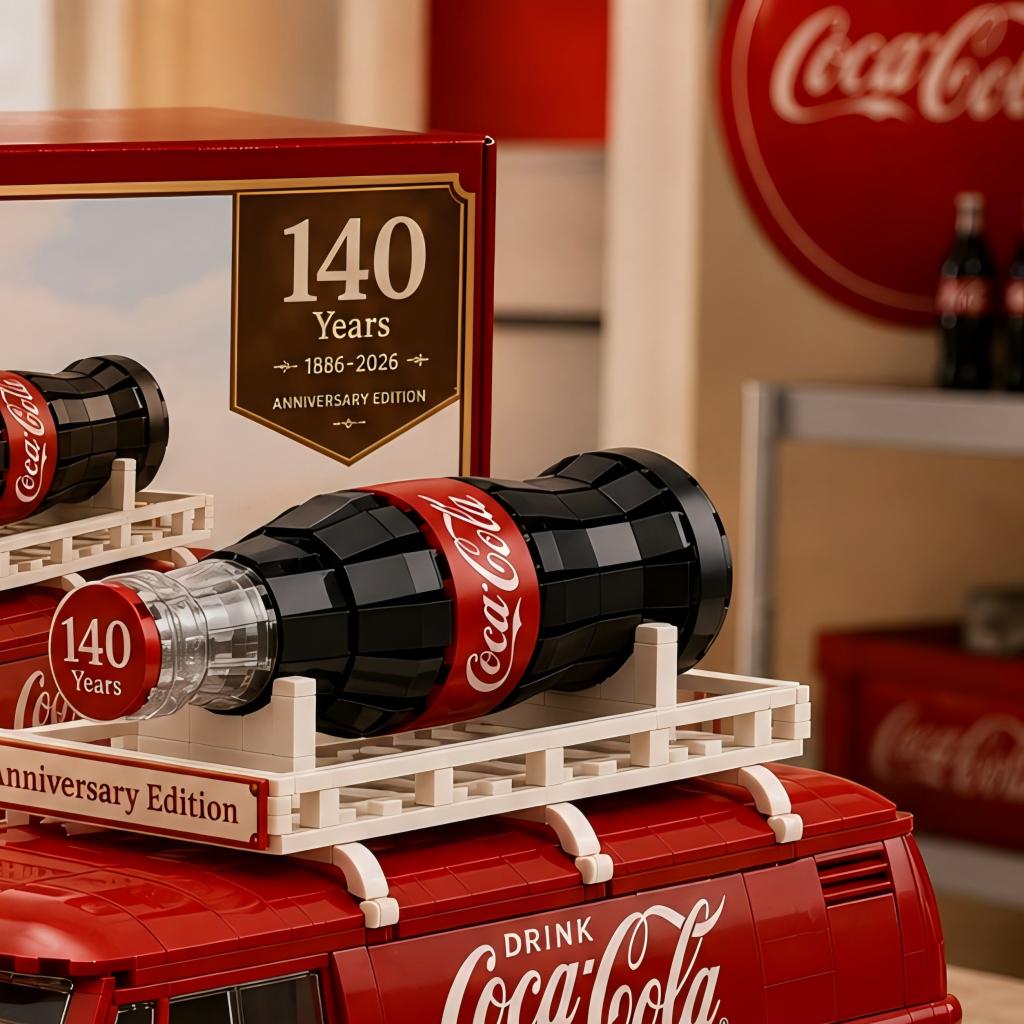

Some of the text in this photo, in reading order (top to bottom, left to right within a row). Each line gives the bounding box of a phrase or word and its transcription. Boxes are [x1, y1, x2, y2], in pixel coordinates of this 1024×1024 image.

[283, 216, 426, 302] 140
[313, 310, 390, 340] Years
[304, 353, 399, 375] 1886-2026
[272, 389, 426, 410] ANNIVERSARY EDITION
[417, 495, 522, 693] Coca-Cola
[61, 616, 132, 669] 140
[71, 669, 123, 696] Years
[146, 783, 240, 825] Edition
[503, 916, 594, 959] DRINK
